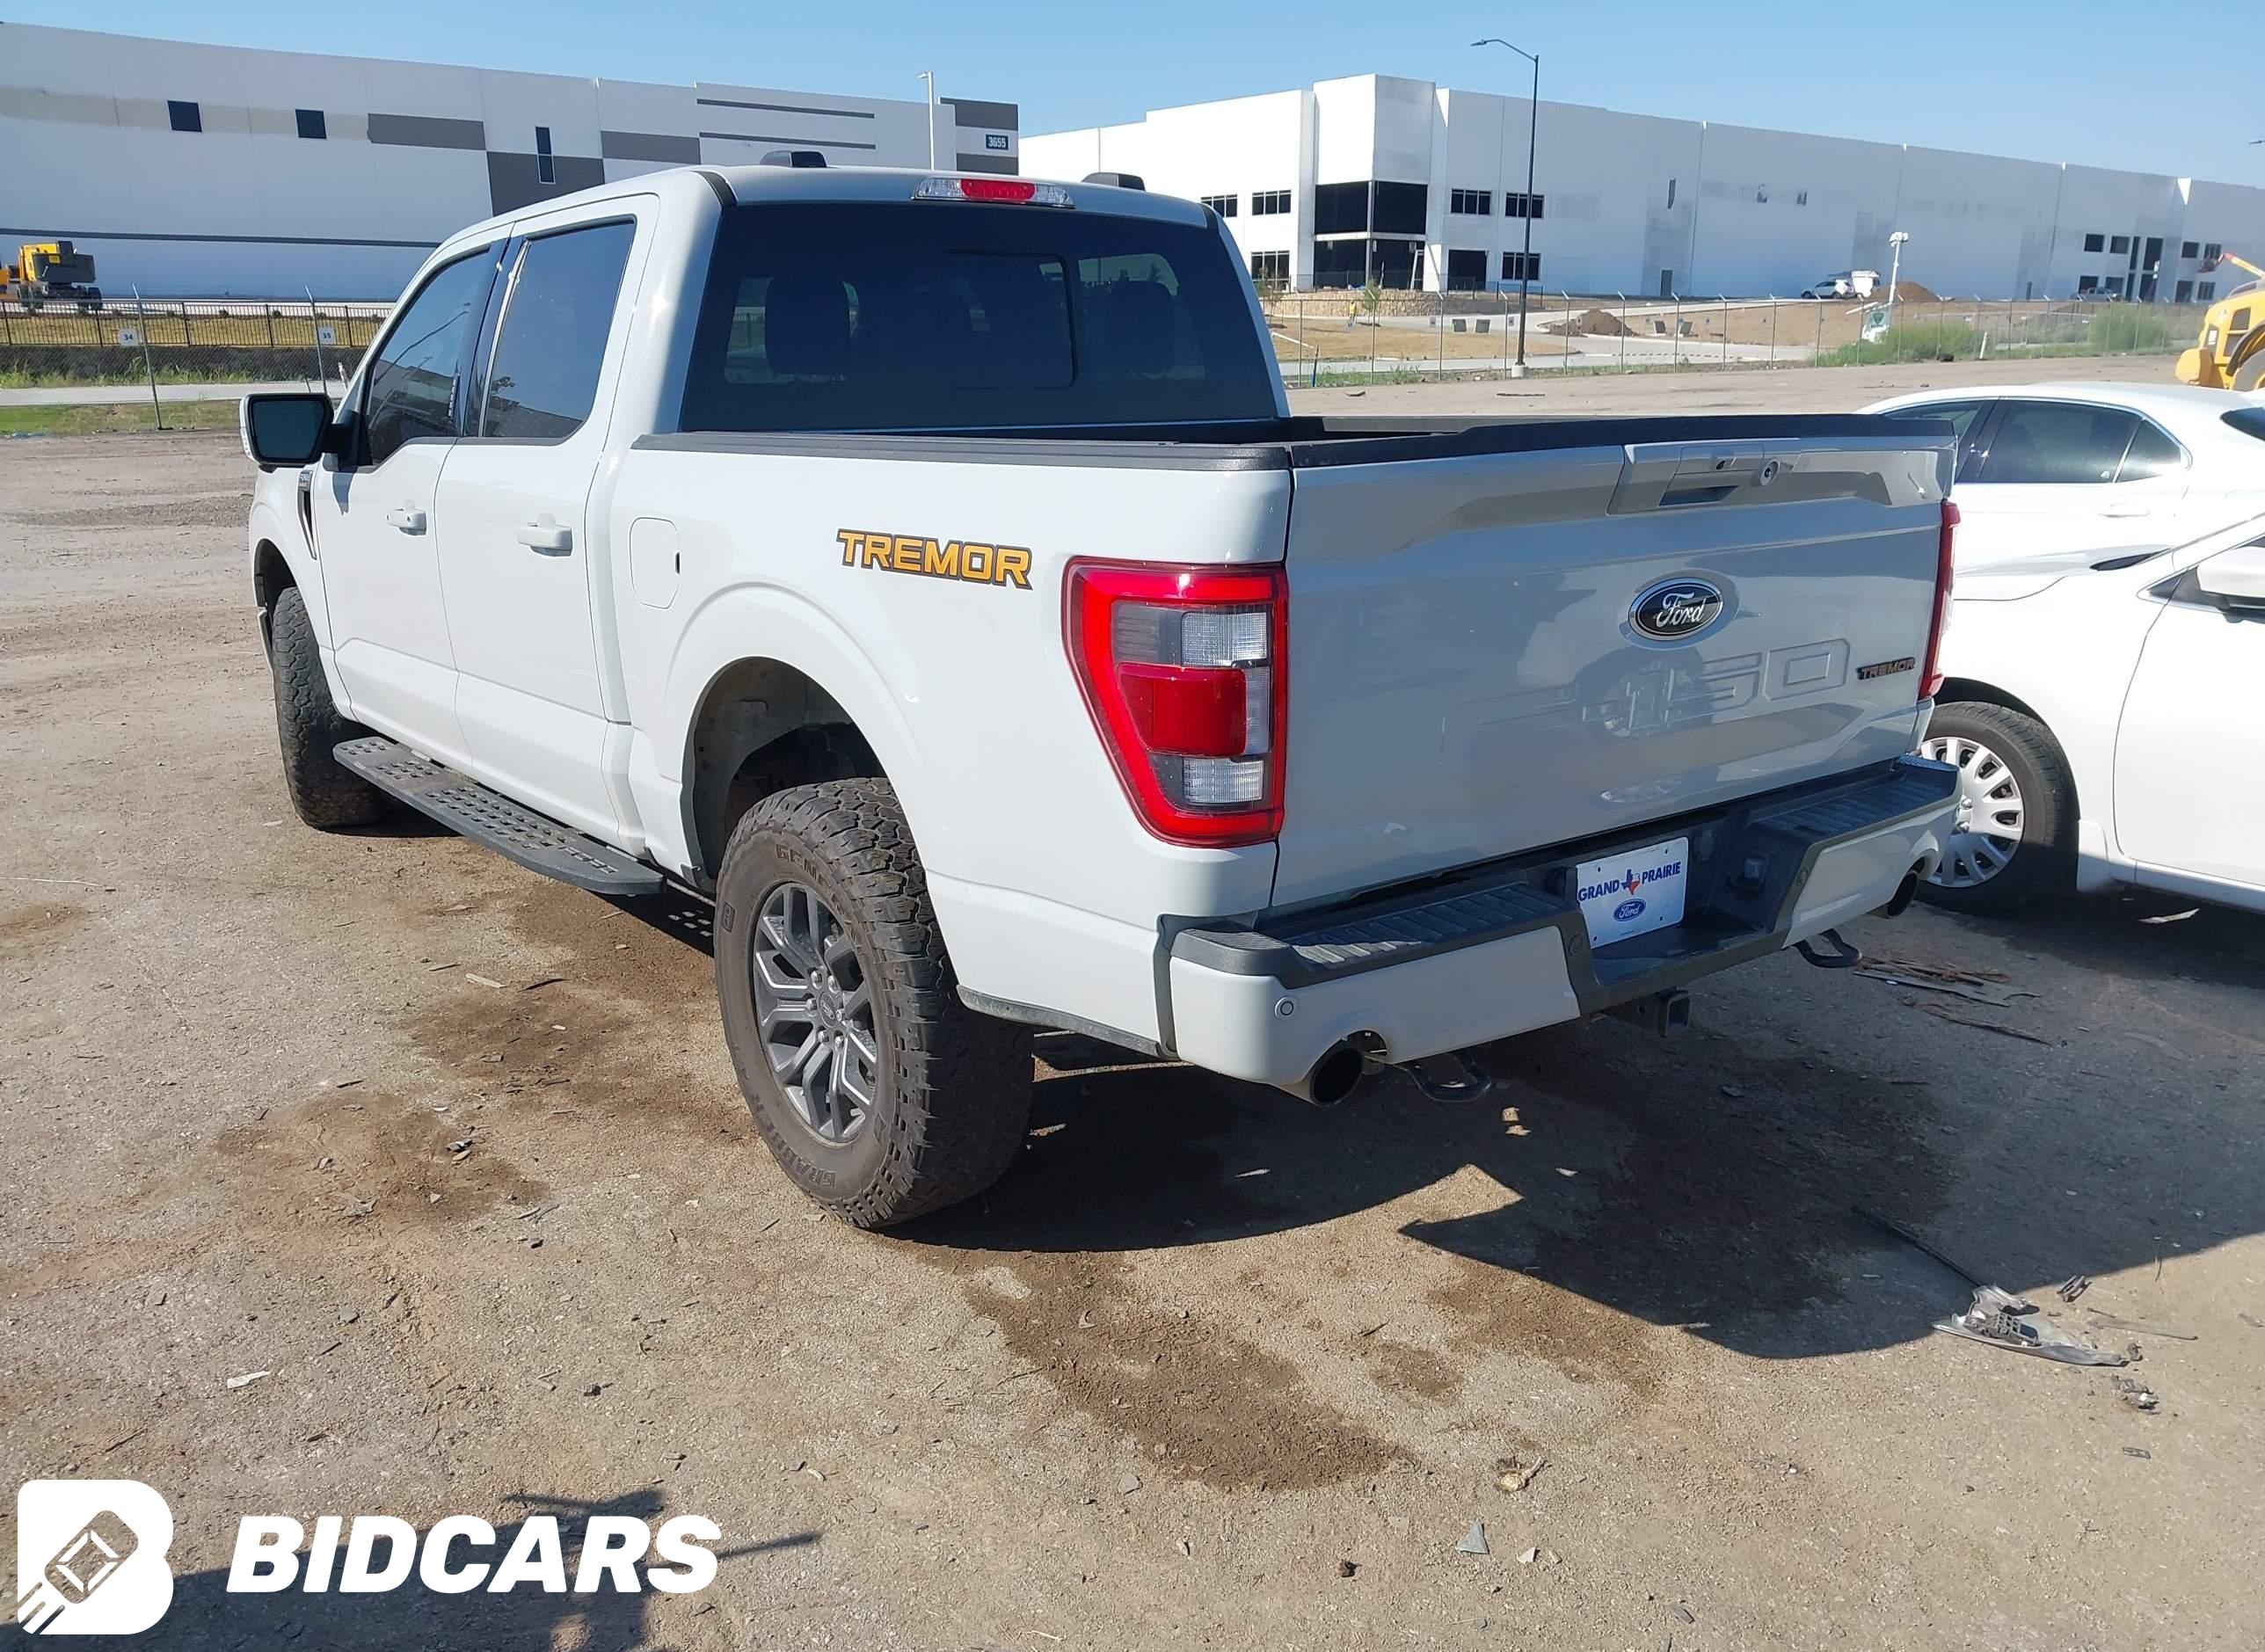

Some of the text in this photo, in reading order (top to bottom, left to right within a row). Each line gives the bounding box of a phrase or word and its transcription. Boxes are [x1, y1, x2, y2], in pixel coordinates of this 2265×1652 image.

[988, 136, 1007, 149] 3655
[836, 528, 1034, 591] TREMOR
[1655, 592, 1707, 628] Ford
[1856, 657, 1916, 680] TREMOR
[1577, 862, 1681, 902] GRAND PRAIRIE
[1619, 903, 1641, 919] Ford
